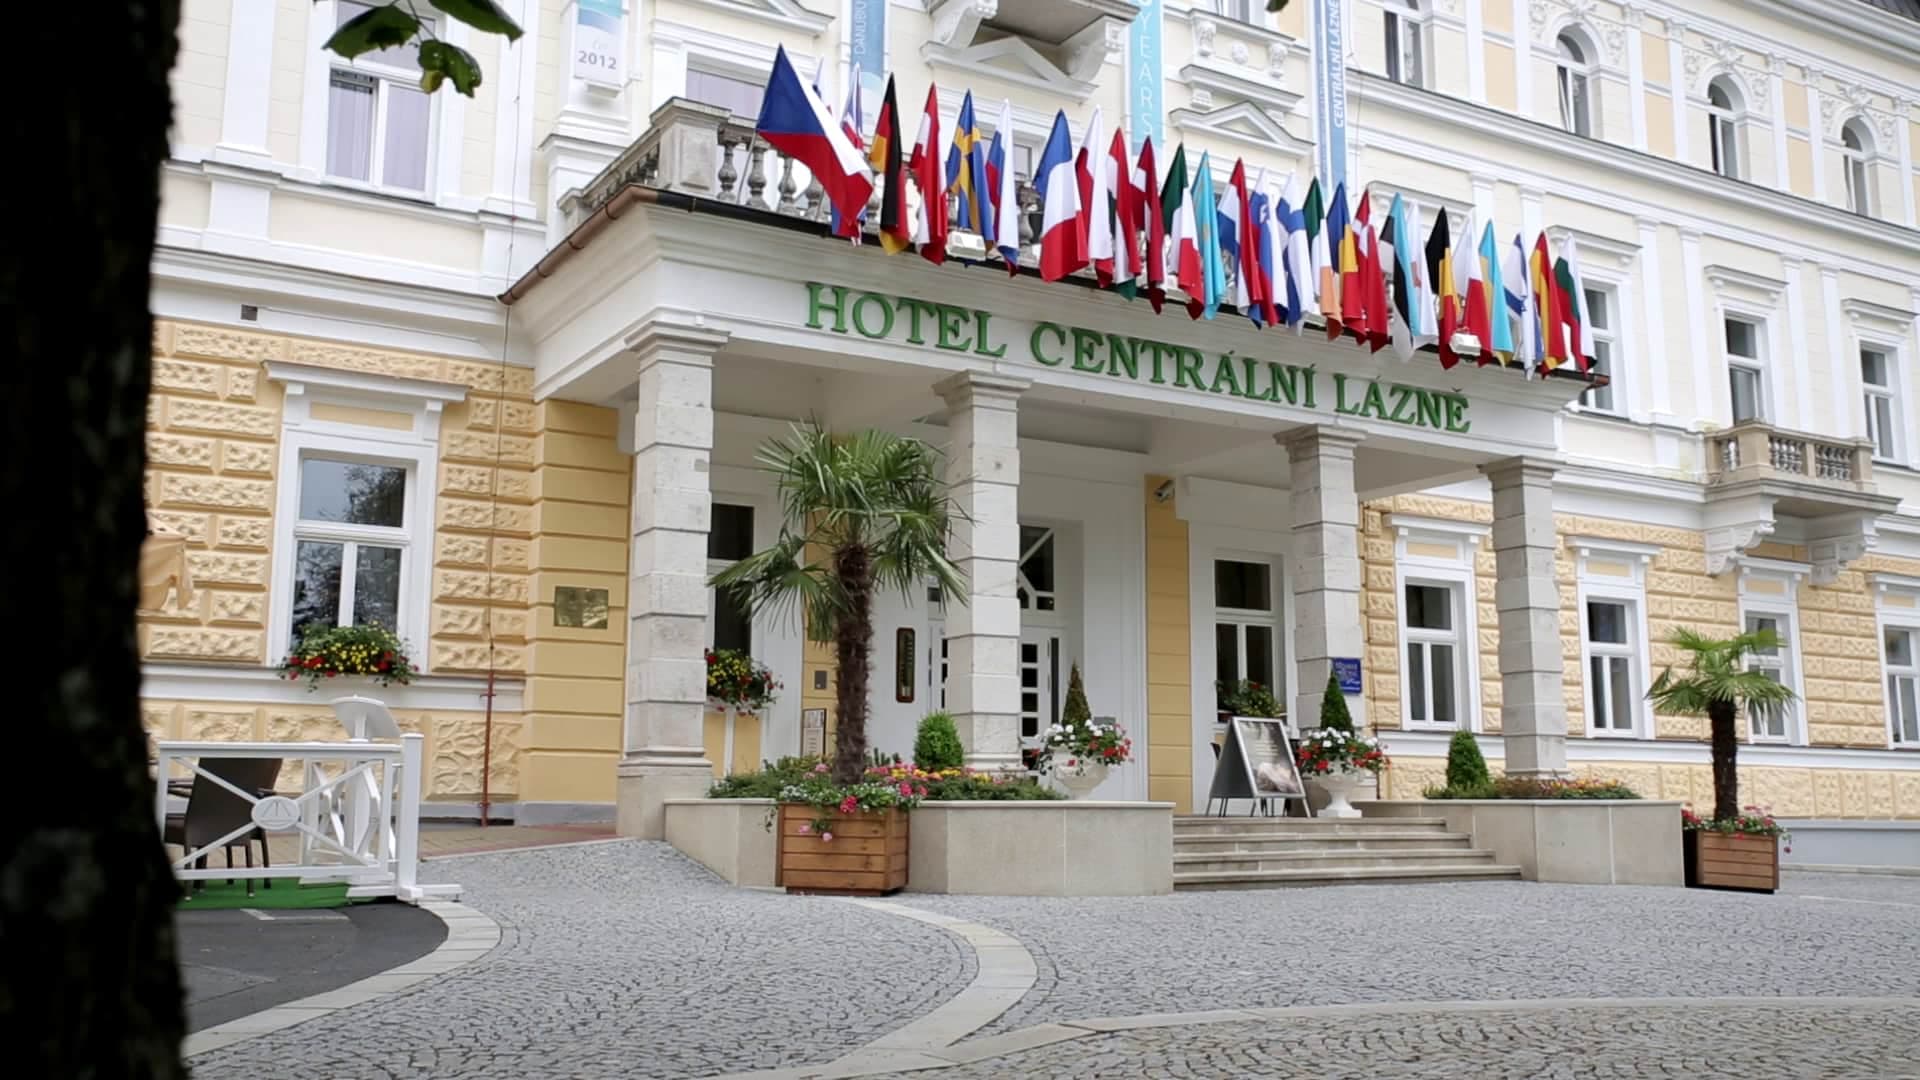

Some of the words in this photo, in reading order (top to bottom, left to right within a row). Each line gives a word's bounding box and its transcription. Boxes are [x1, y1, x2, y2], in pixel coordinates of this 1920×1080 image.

[578, 50, 617, 70] 2012
[1138, 11, 1153, 136] YEARS
[805, 281, 1007, 358] HOTEL
[1030, 321, 1317, 408] CENTRÁLNÍ
[1333, 373, 1472, 433] LÁZNĚ
